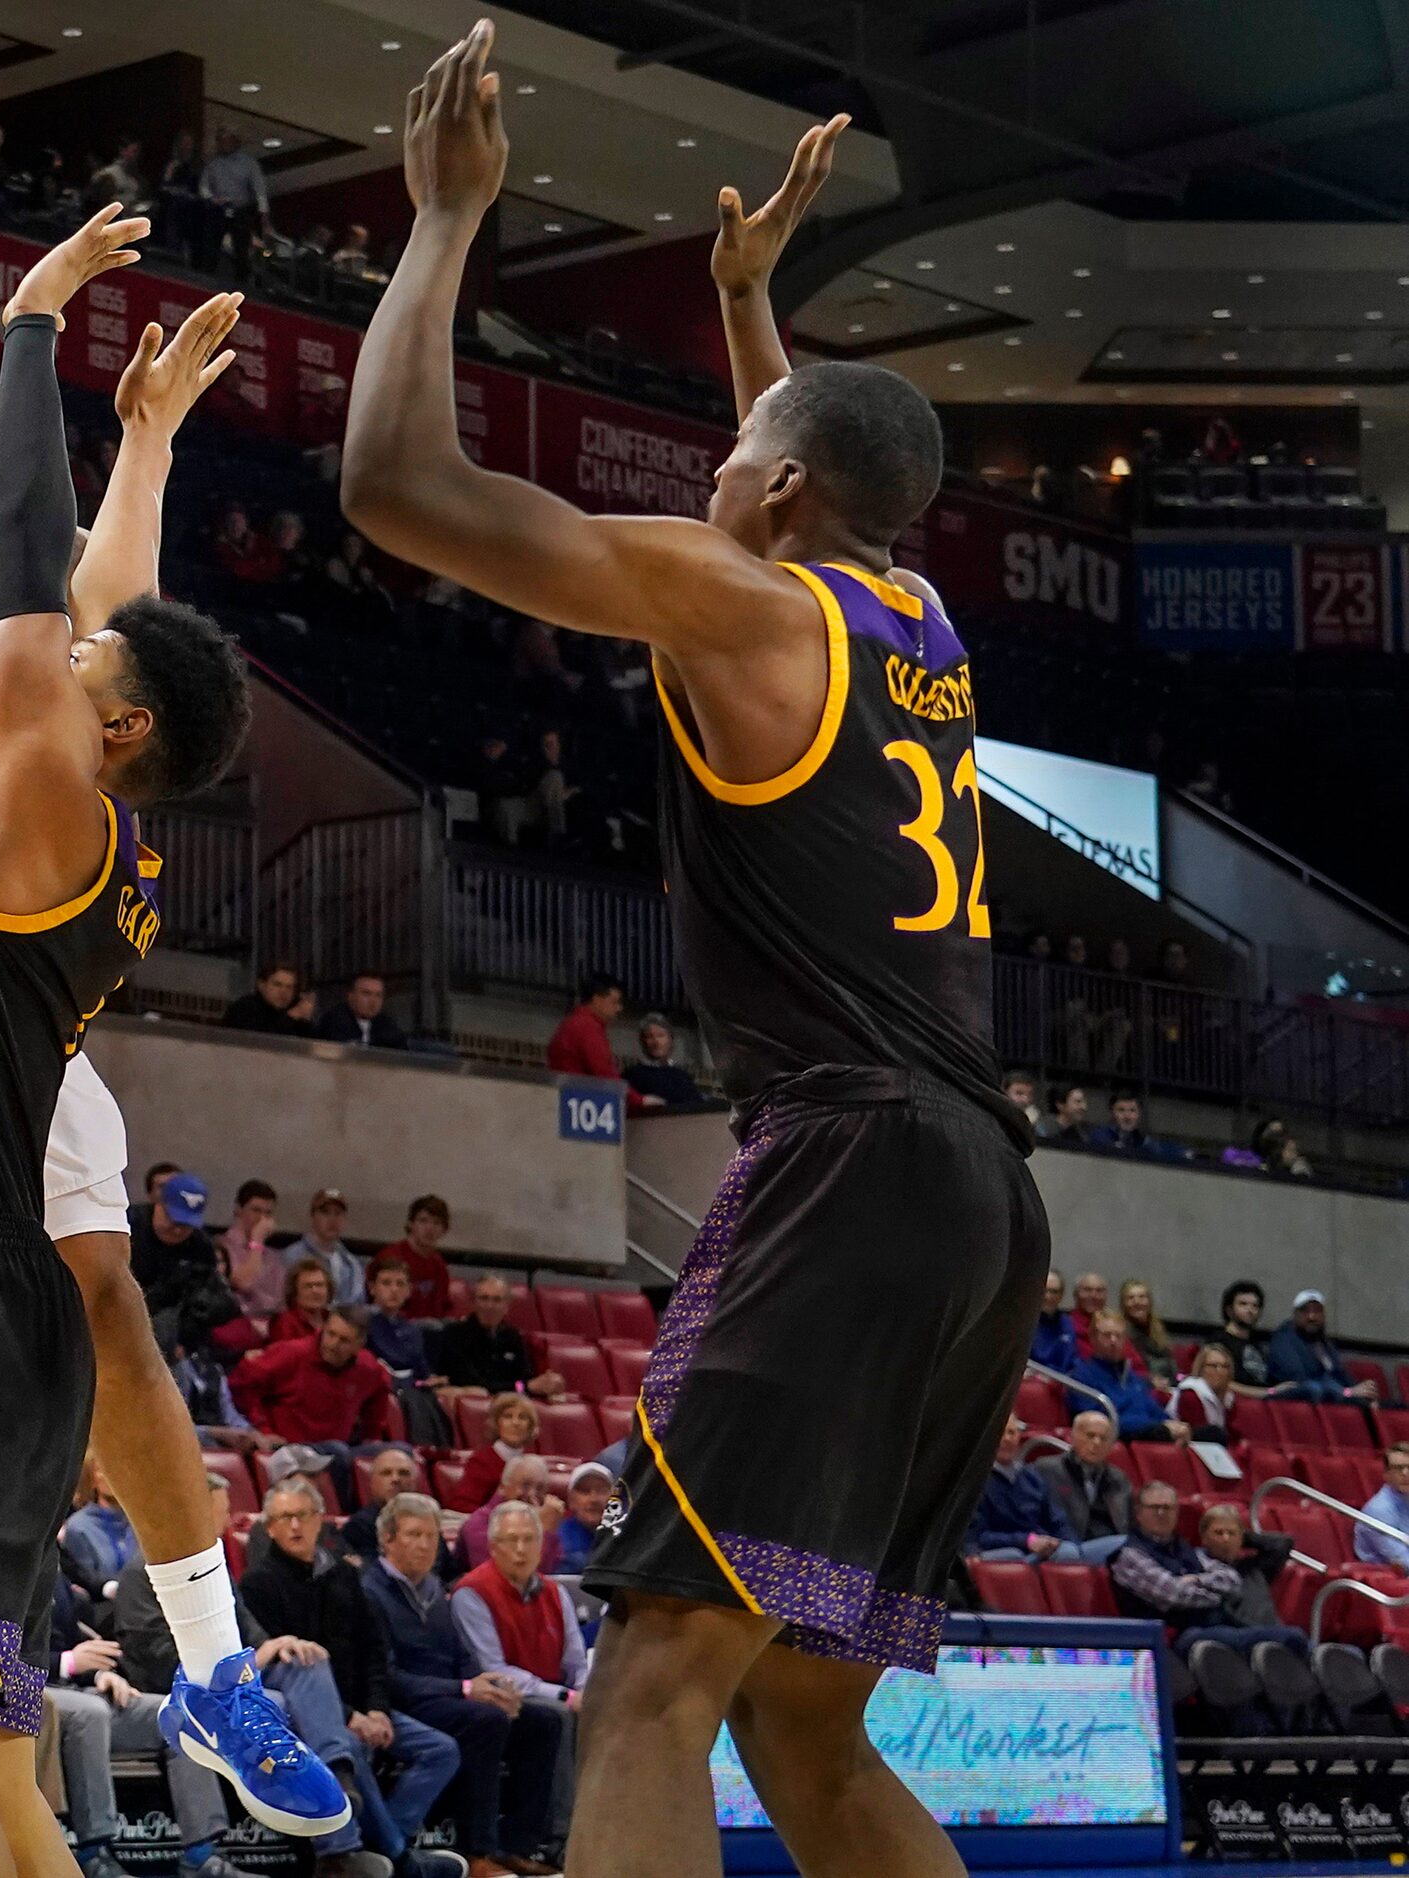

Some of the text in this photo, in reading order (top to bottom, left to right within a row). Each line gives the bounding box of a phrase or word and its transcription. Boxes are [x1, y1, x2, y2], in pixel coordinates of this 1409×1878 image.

[580, 416, 711, 484] CONFERENCE
[1004, 531, 1121, 625] SMU
[1142, 566, 1282, 600] HONORED
[1311, 571, 1375, 625] 23
[1146, 599, 1282, 631] JERSEYS
[567, 1097, 616, 1135] 104
[919, 1700, 1130, 1771] Market
